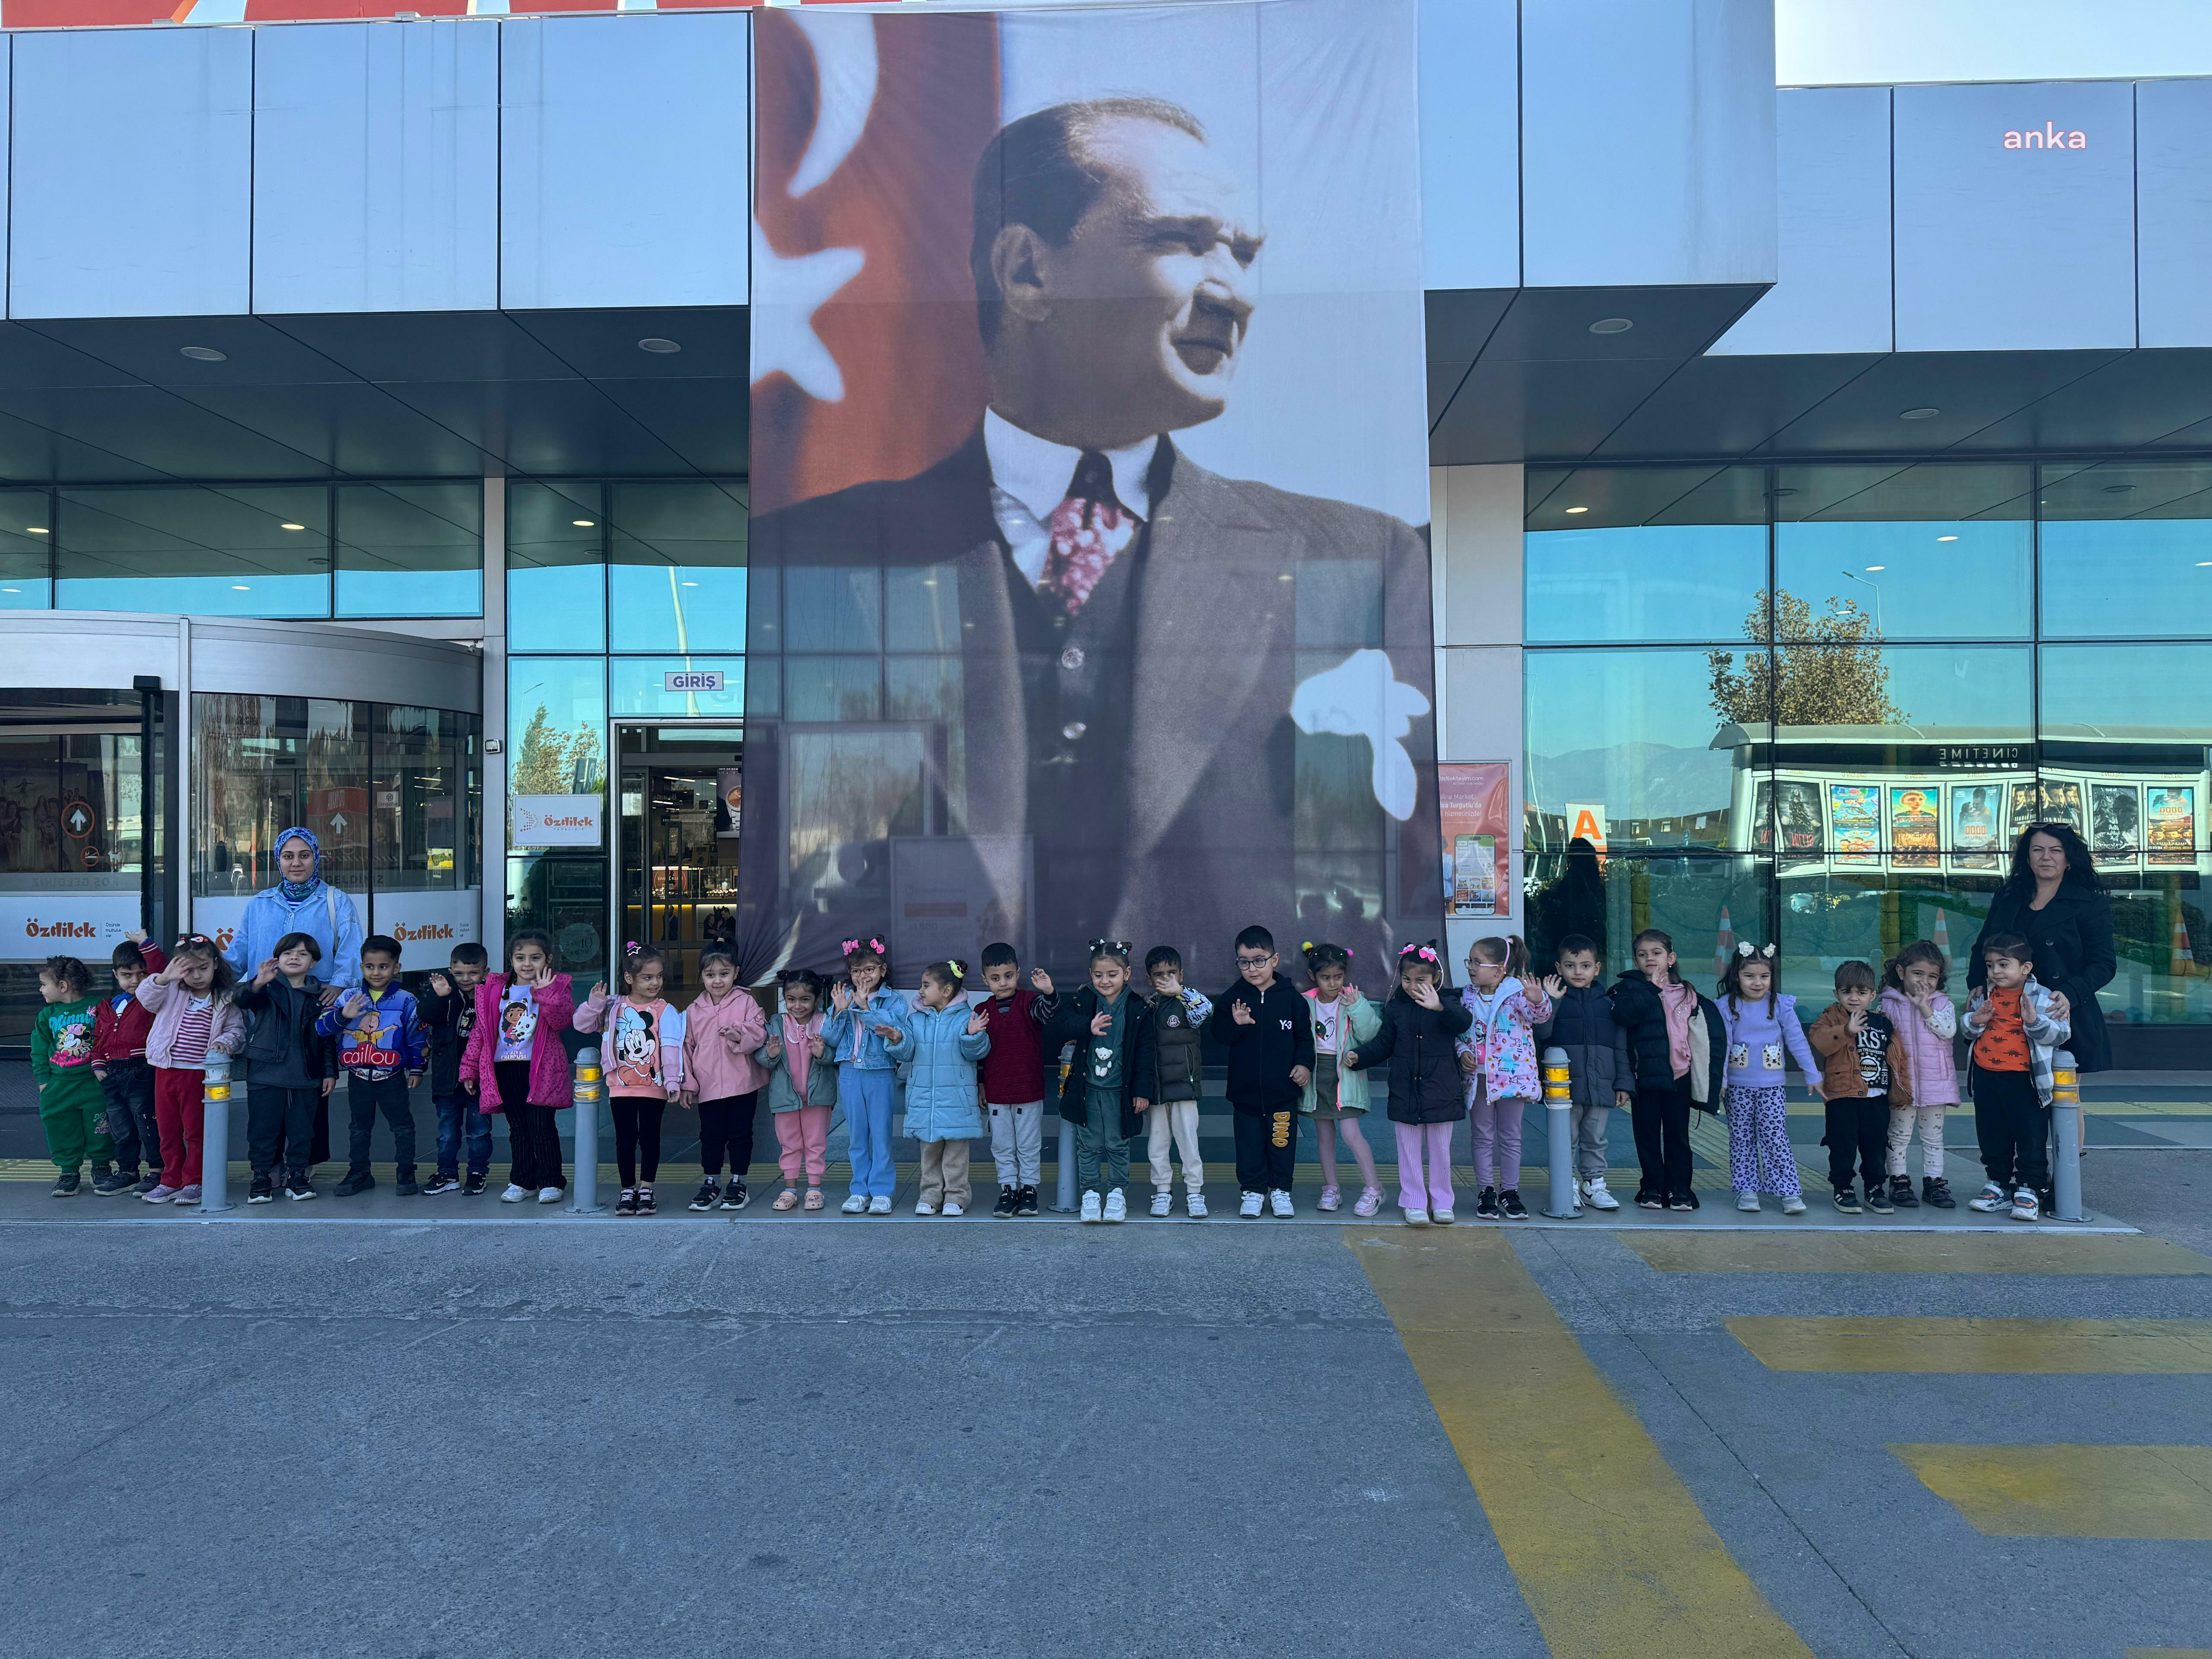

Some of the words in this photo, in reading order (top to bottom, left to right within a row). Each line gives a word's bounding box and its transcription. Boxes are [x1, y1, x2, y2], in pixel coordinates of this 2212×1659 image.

[2003, 120, 2087, 149] anka
[673, 673, 716, 690] GİRİŞ
[543, 814, 594, 826] Özdilek
[1573, 810, 1602, 840] A
[26, 918, 96, 938] Özdilek
[394, 922, 454, 941] Özdilek
[1279, 1020, 1292, 1030] Y-3
[343, 1043, 395, 1065] caillou
[1272, 1112, 1290, 1147] DINO
